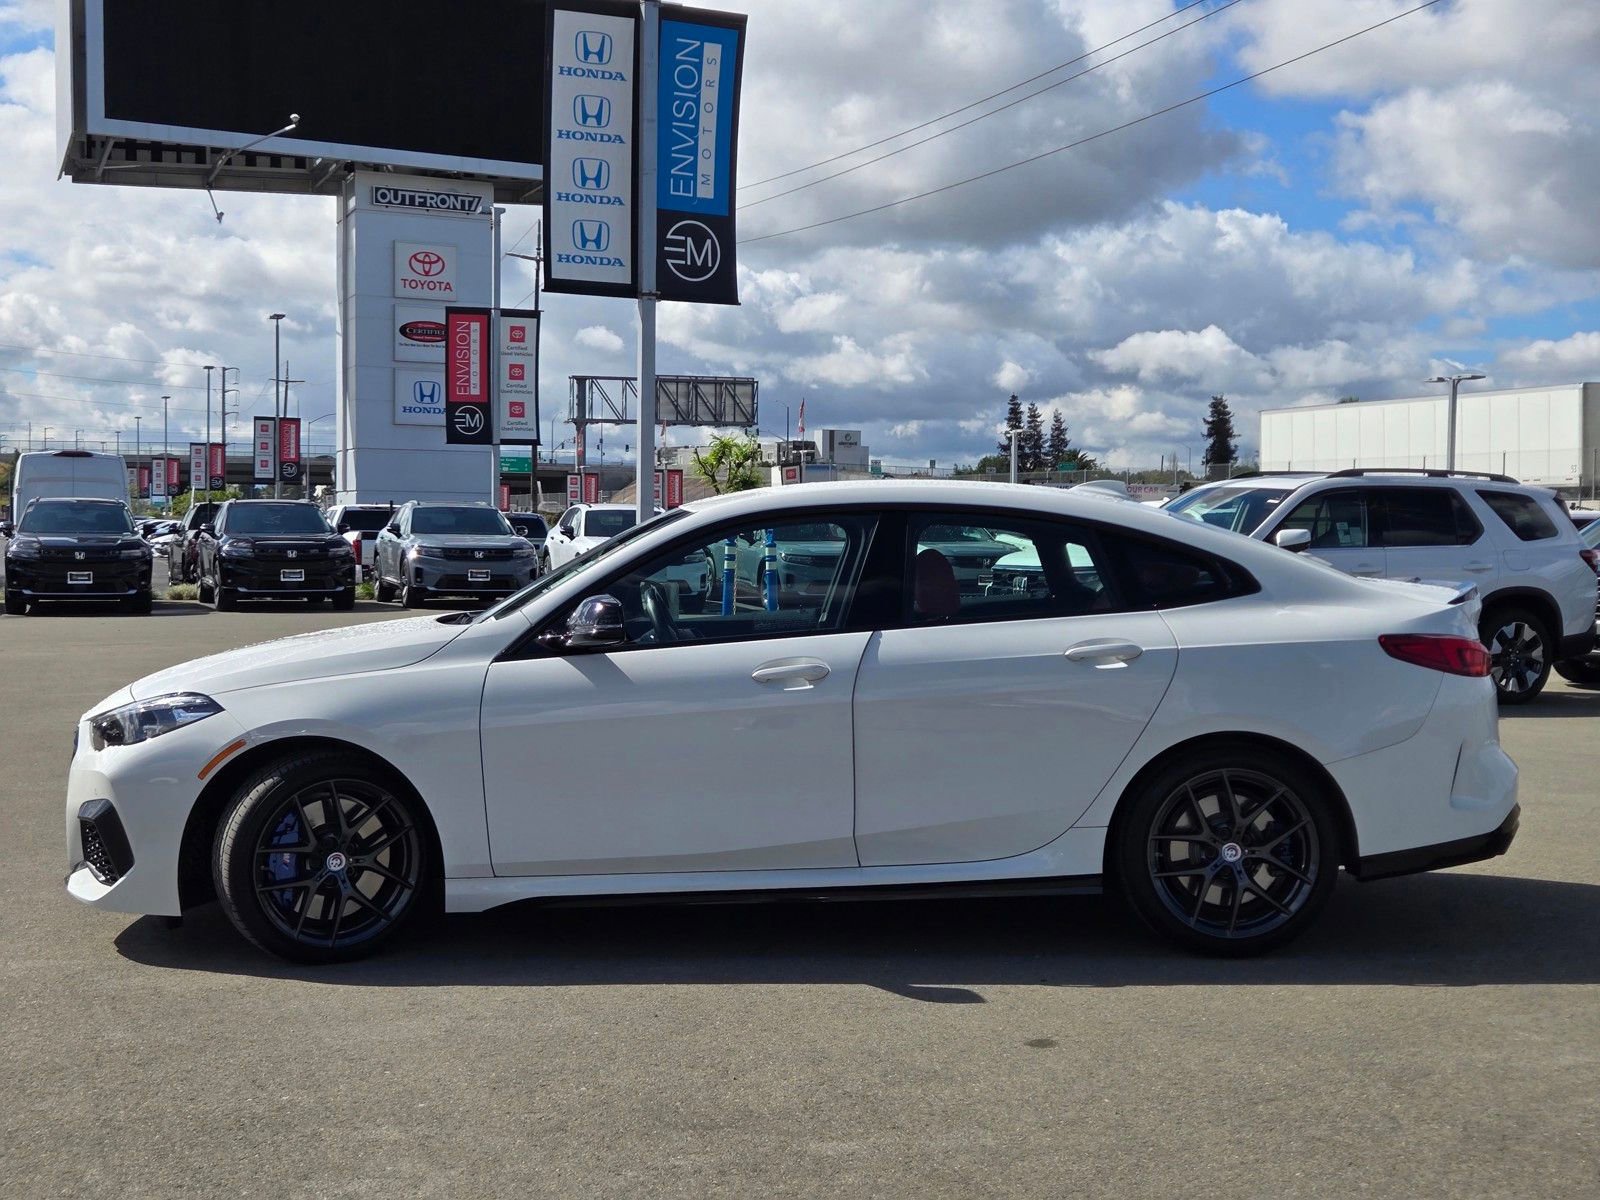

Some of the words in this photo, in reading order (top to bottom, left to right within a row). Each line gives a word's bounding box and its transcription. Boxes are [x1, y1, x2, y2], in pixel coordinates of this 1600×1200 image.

[558, 65, 627, 82] HONDA
[670, 38, 700, 197] ENVISION
[701, 57, 717, 186] MOTORS
[556, 129, 626, 145] HONDA
[556, 191, 625, 206] HONDA
[556, 253, 625, 267] HONDA
[400, 278, 453, 292] TOYOTA
[406, 326, 446, 336] CERTIFIE
[456, 321, 469, 395] ENVISION
